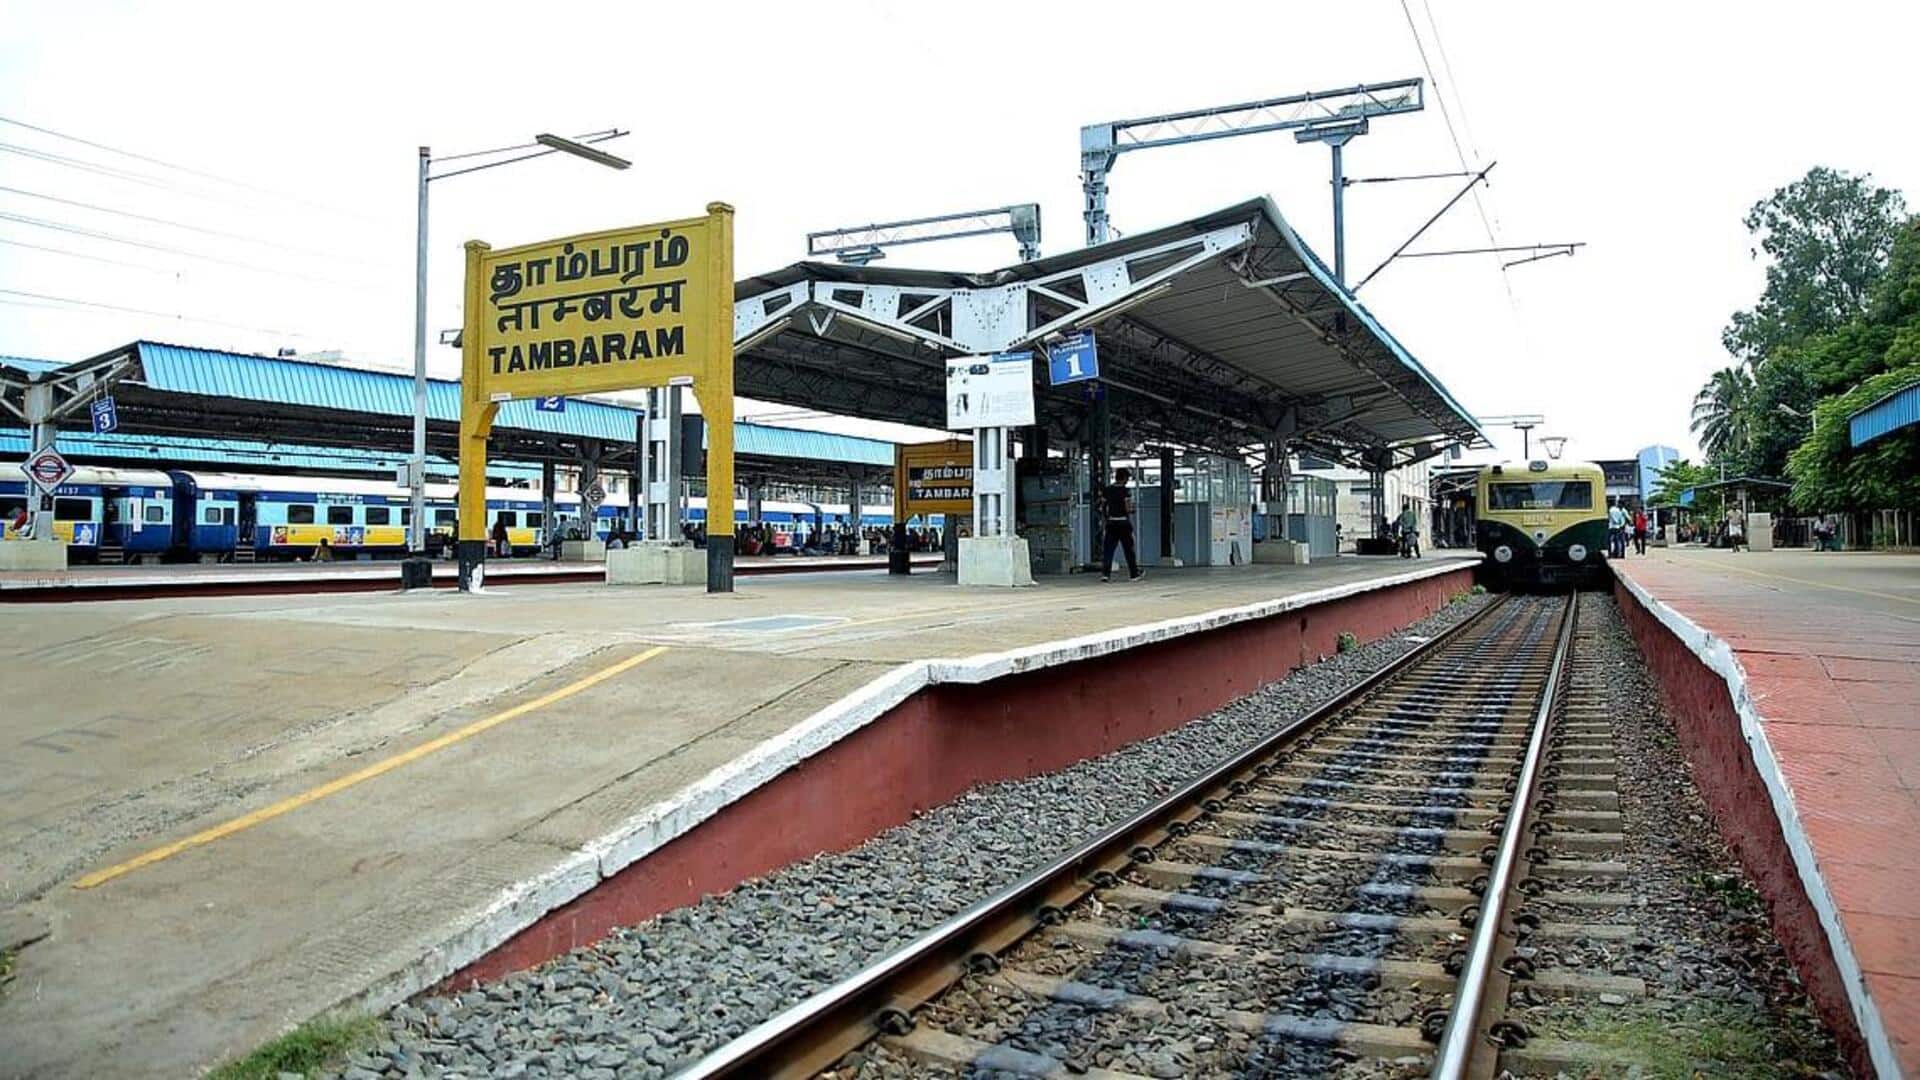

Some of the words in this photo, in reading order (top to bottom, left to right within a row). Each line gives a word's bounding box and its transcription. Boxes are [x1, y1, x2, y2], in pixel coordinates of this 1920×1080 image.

[489, 228, 689, 305] தாம்பரம்
[497, 279, 687, 334] ताम्बरम
[488, 325, 684, 374] TAMBARAM
[1066, 353, 1083, 377] 1
[99, 413, 111, 430] 3
